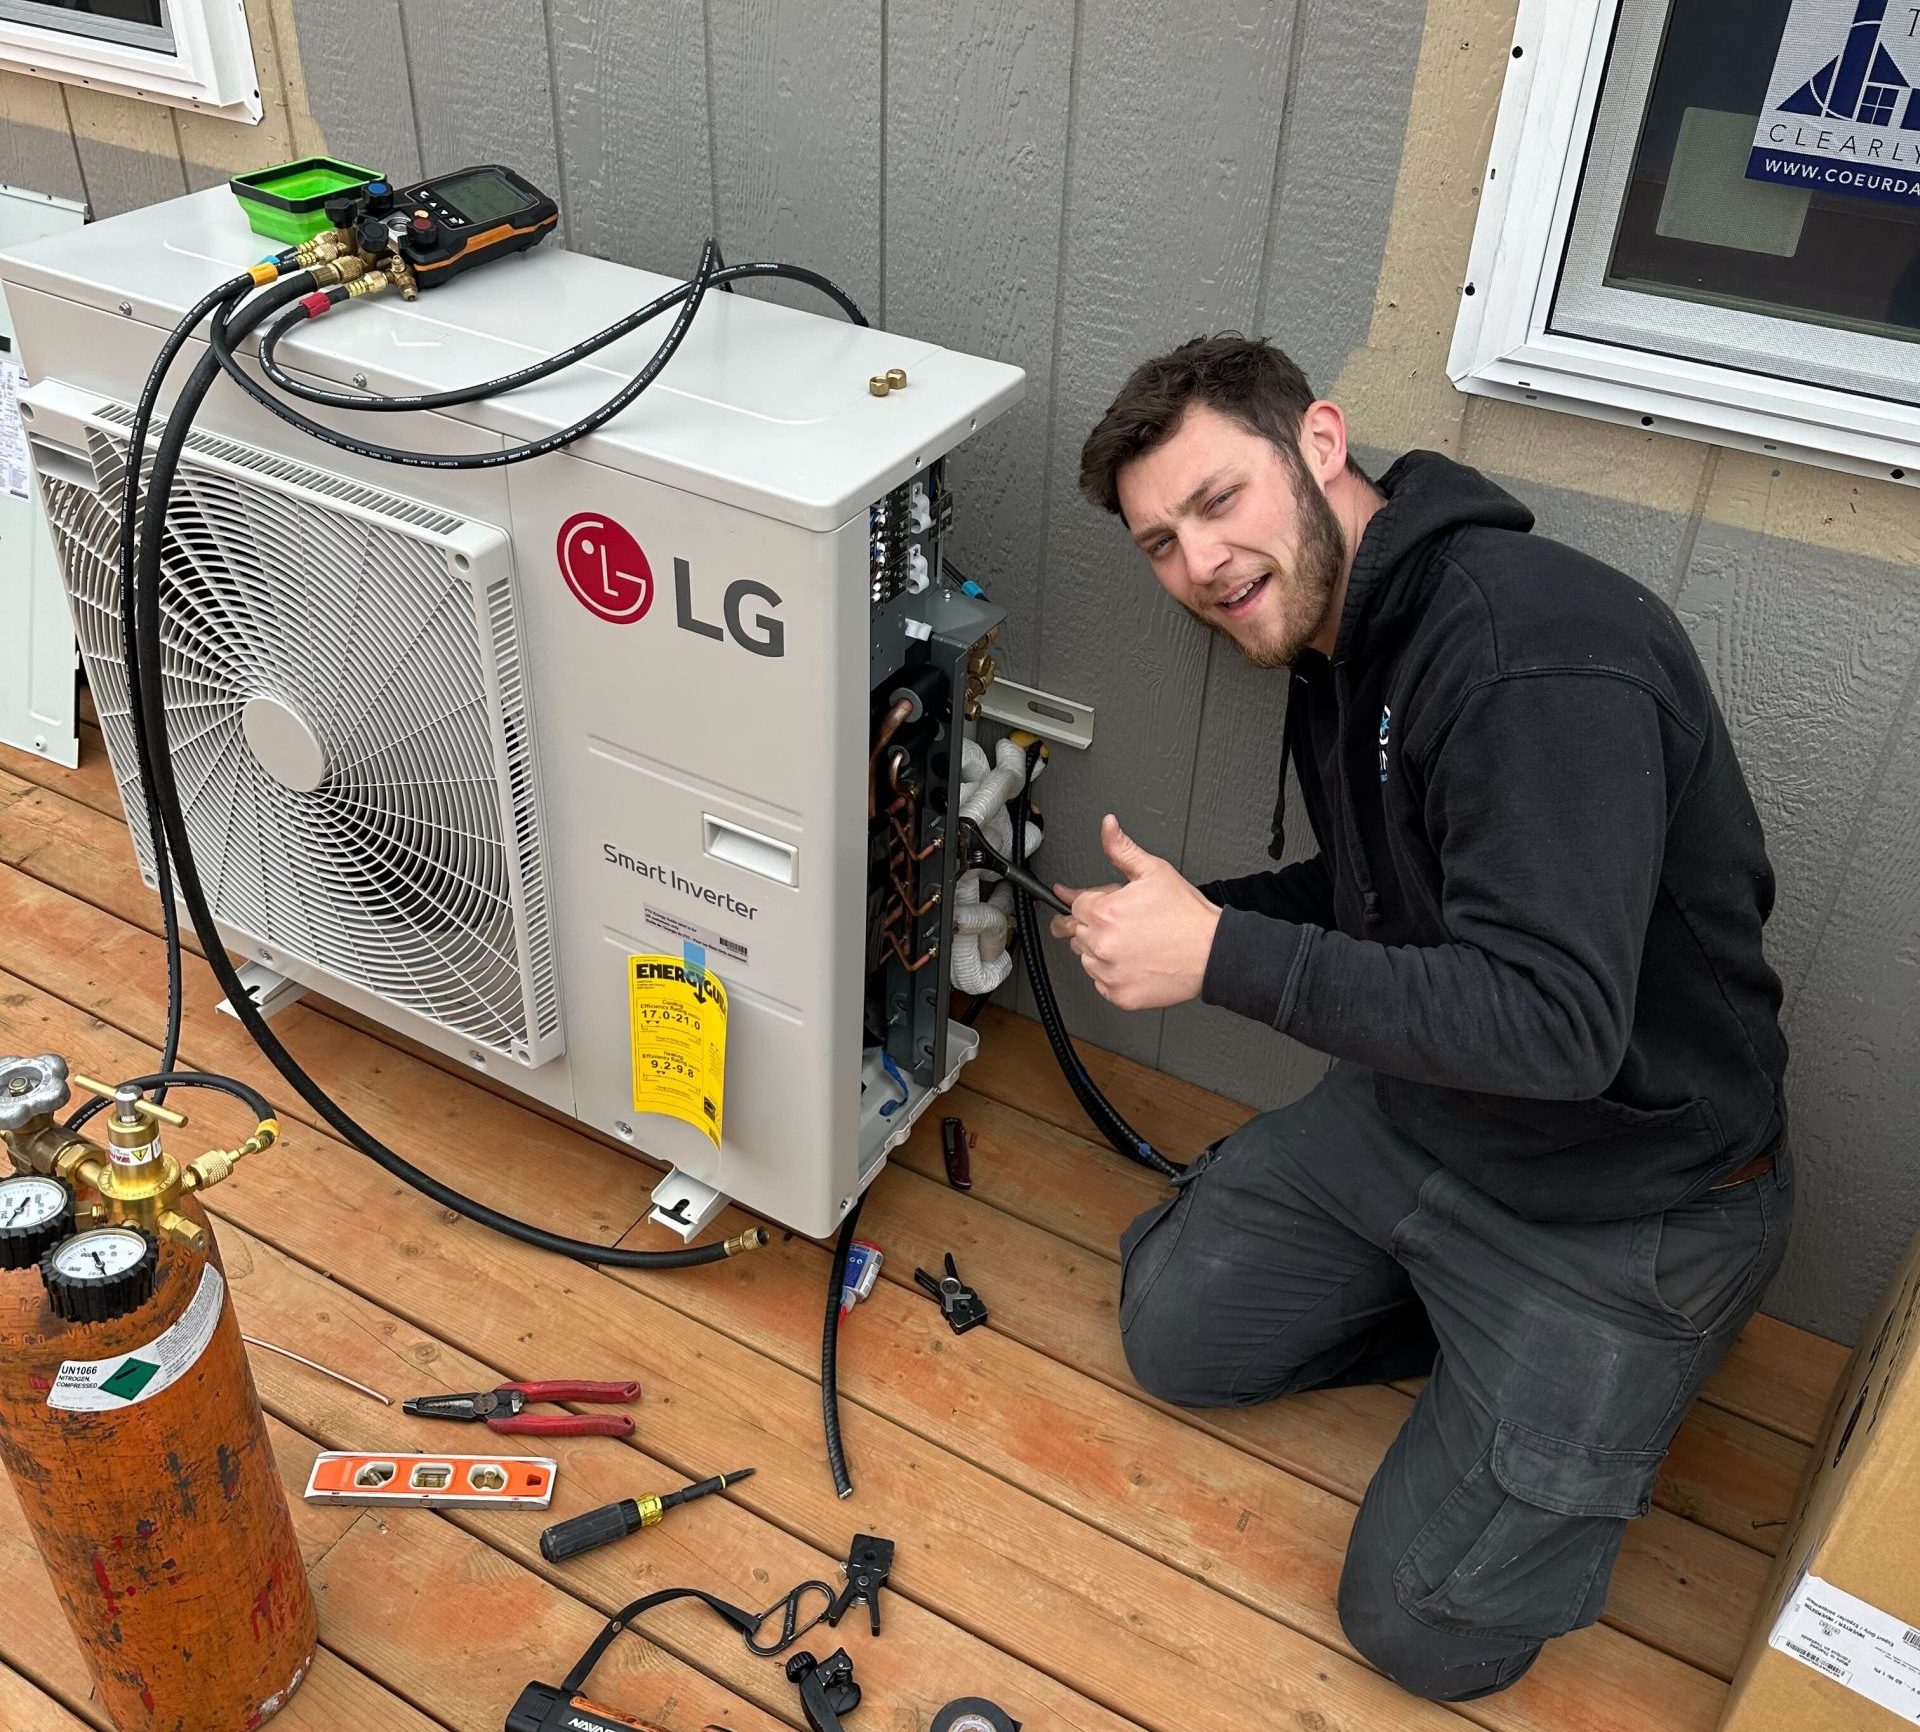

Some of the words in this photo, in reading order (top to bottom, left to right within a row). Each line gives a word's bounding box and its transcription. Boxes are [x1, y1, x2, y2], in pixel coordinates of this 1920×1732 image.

[673, 556, 785, 658] LG
[603, 843, 667, 885] Smart
[671, 871, 758, 920] Inverter
[640, 1003, 669, 1011] Efficiency
[662, 1000, 684, 1010] Cooling
[642, 1010, 700, 1030] 17.0-21.0
[651, 1060, 694, 1078] 9.2-9.8
[61, 1366, 98, 1375] UN1066
[56, 1381, 98, 1389] COMPRESSED
